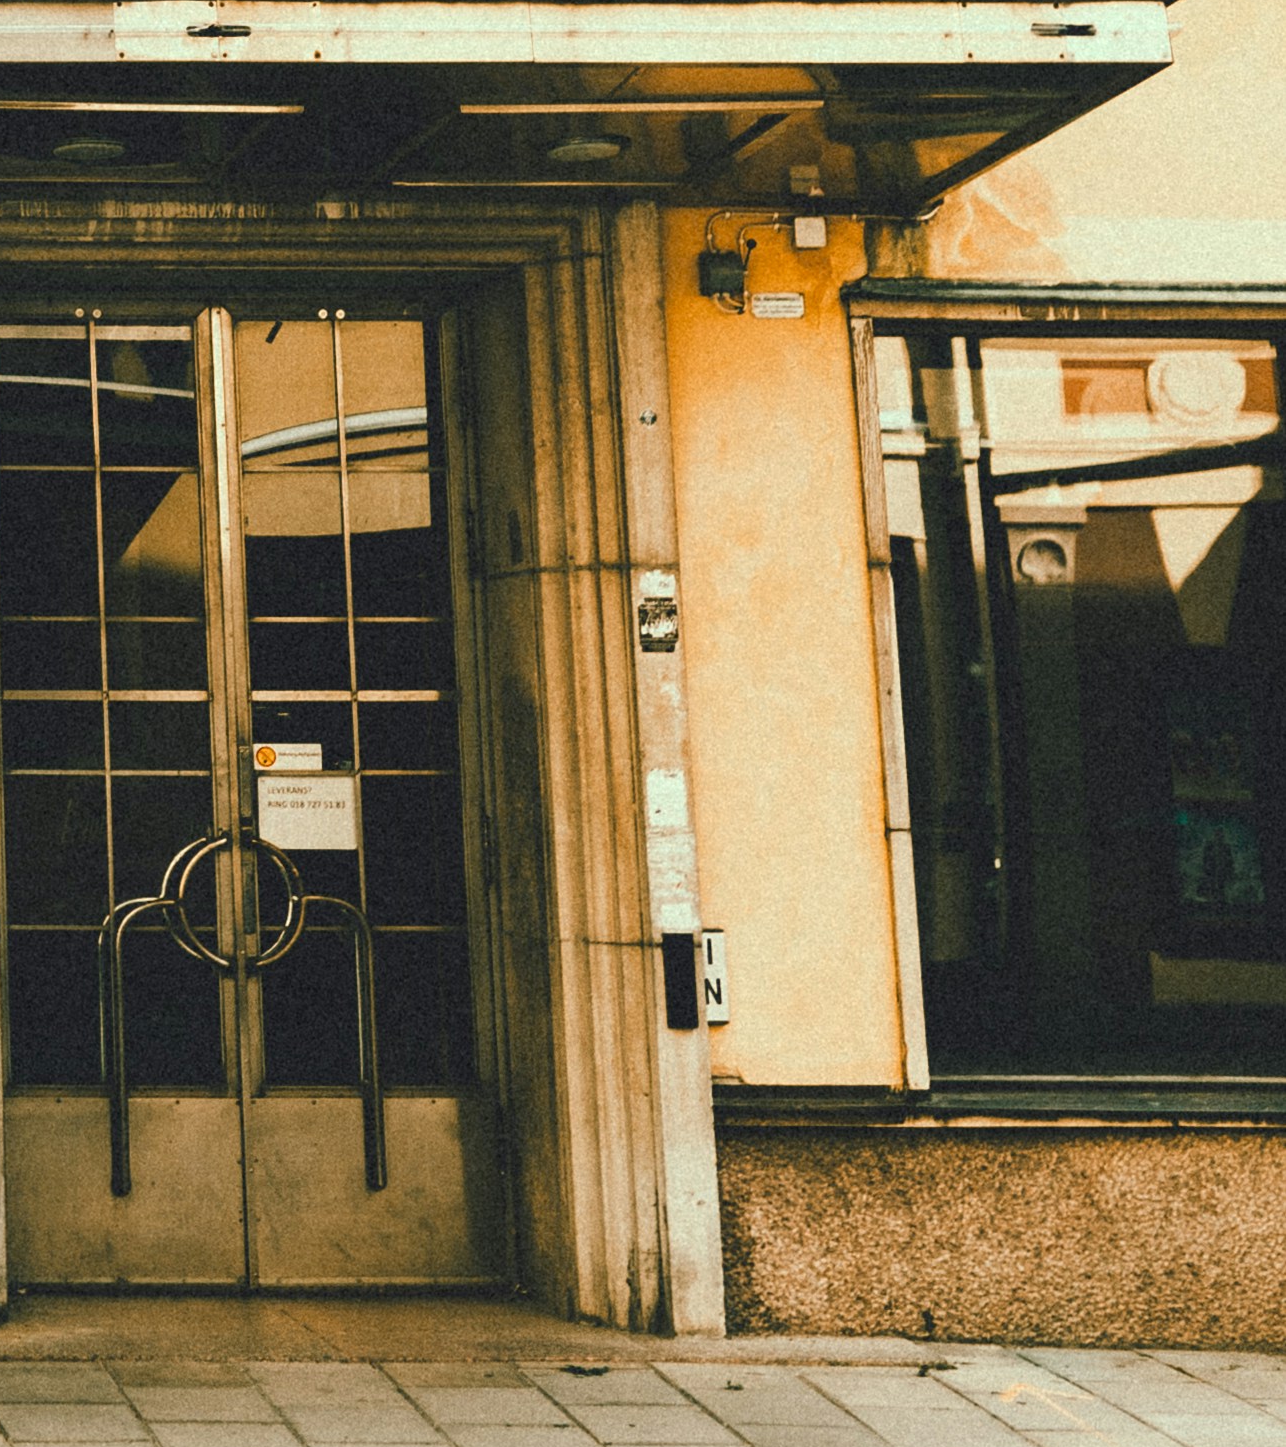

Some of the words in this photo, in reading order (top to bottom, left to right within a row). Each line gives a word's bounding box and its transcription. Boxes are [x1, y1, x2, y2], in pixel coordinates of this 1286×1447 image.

[268, 800, 287, 809] RING
[290, 800, 305, 809] 018
[308, 800, 321, 809] 727
[323, 800, 333, 809] 51
